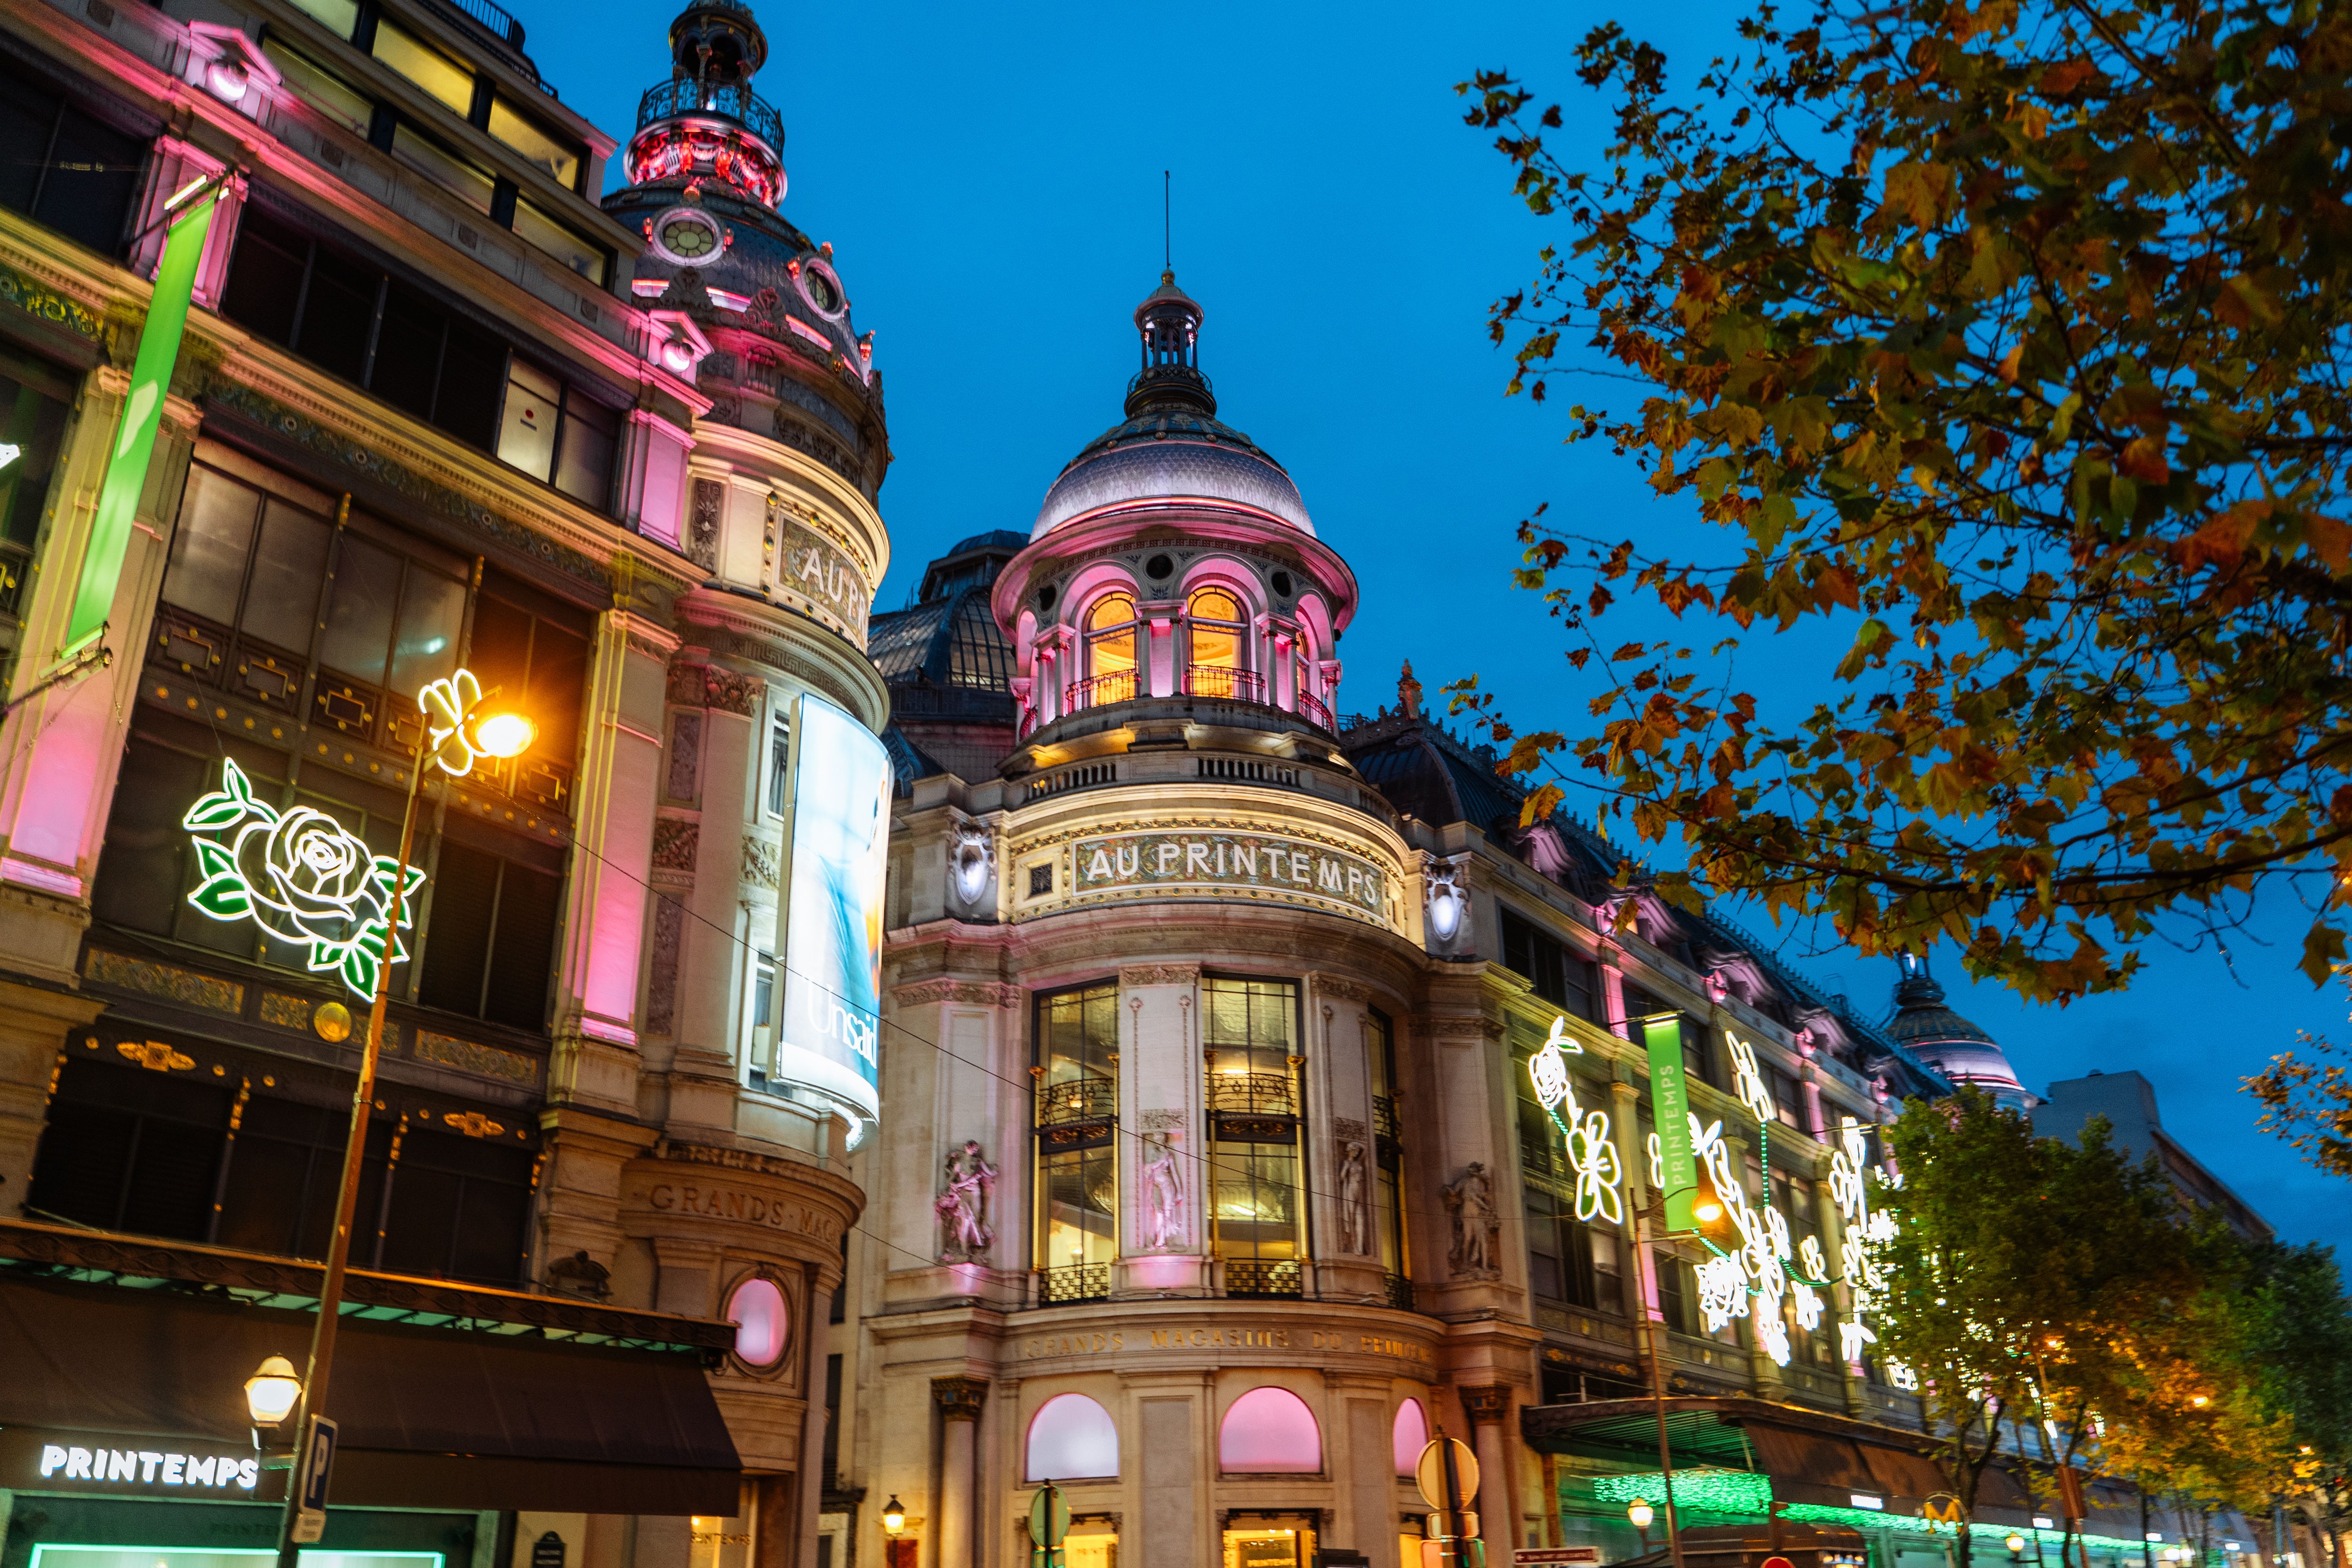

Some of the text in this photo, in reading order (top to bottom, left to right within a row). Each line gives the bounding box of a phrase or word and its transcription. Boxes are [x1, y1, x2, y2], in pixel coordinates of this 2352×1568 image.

[801, 548, 866, 636] AU PR
[1086, 844, 1377, 904] AU PRINTEMPS
[802, 974, 877, 1069] Unsaid
[1660, 1064, 1688, 1186] PRINTEMPS
[649, 1184, 784, 1226] GRANDS
[1025, 1332, 1124, 1358] GRANDS
[1151, 1329, 1289, 1349] MAGASINS
[1312, 1331, 1342, 1350] DU
[40, 1445, 259, 1489] PRINTEMPS
[309, 1433, 330, 1499] P
